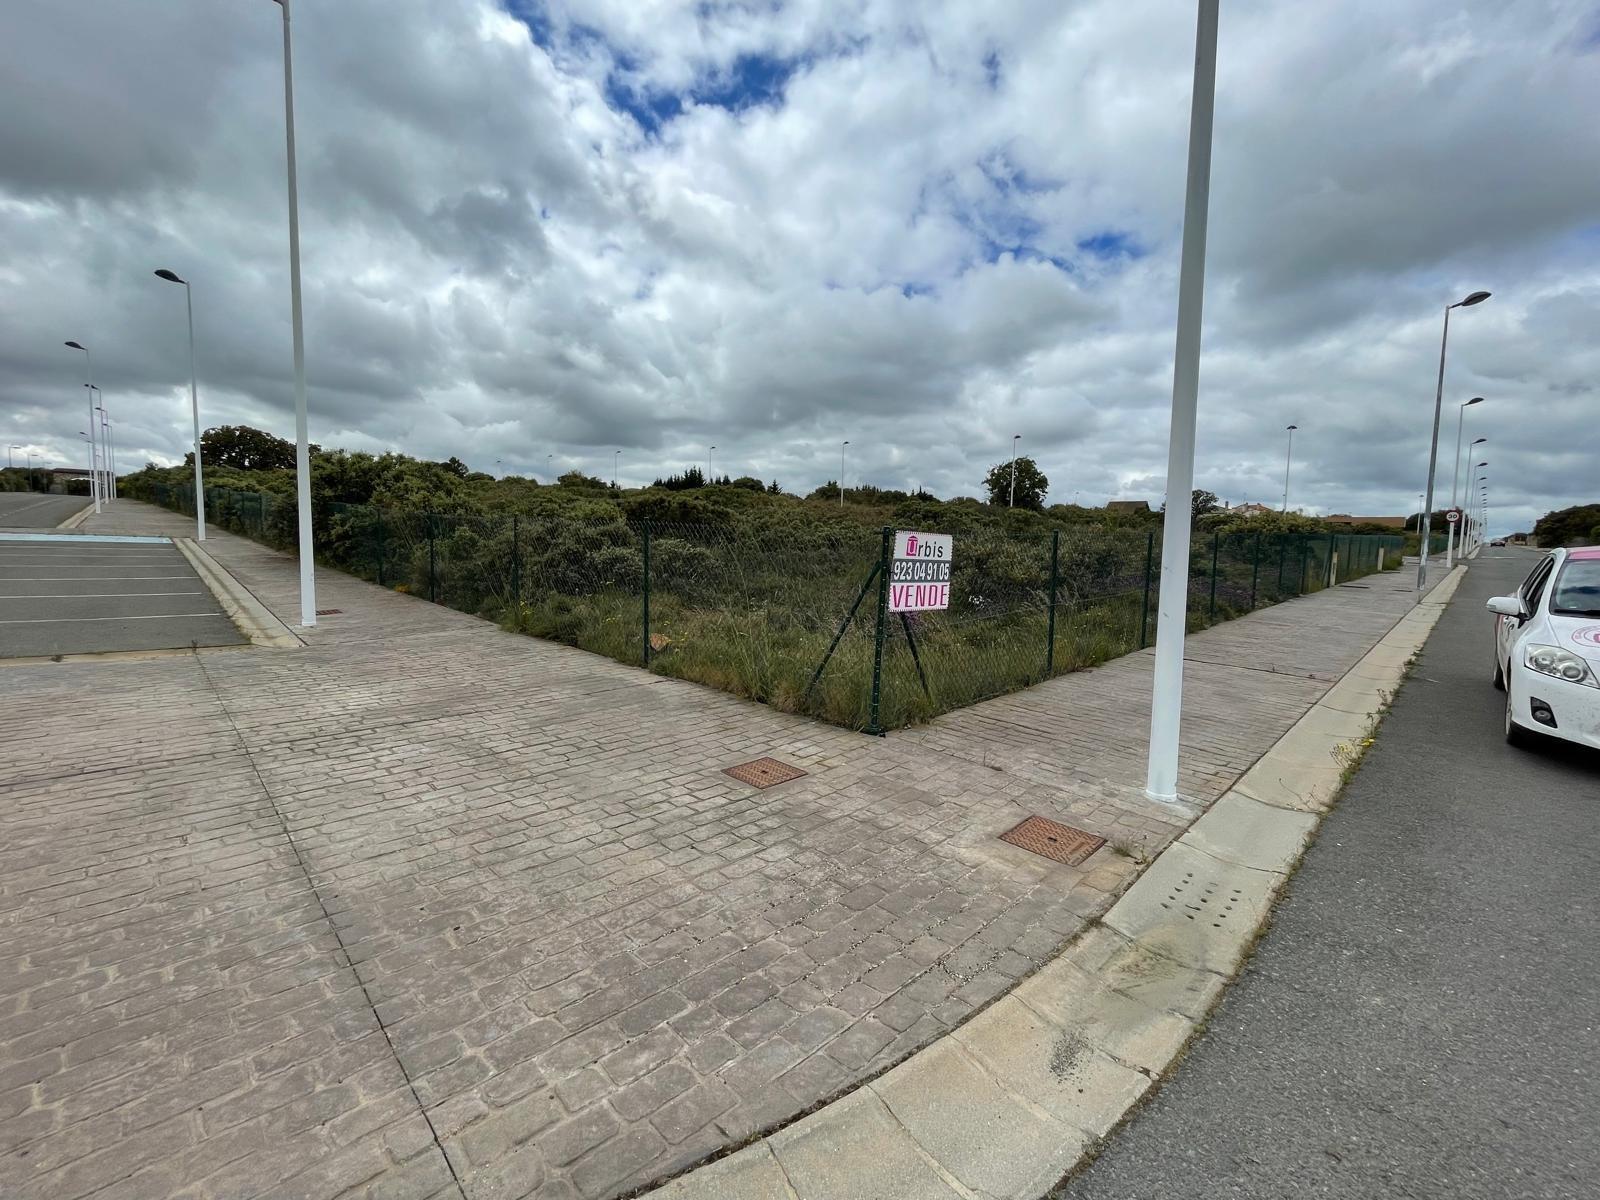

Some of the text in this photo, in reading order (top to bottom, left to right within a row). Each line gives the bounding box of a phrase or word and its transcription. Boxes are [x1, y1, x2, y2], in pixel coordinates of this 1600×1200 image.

[893, 561, 950, 580] 923 04 91 05
[892, 584, 948, 608] VENDE
